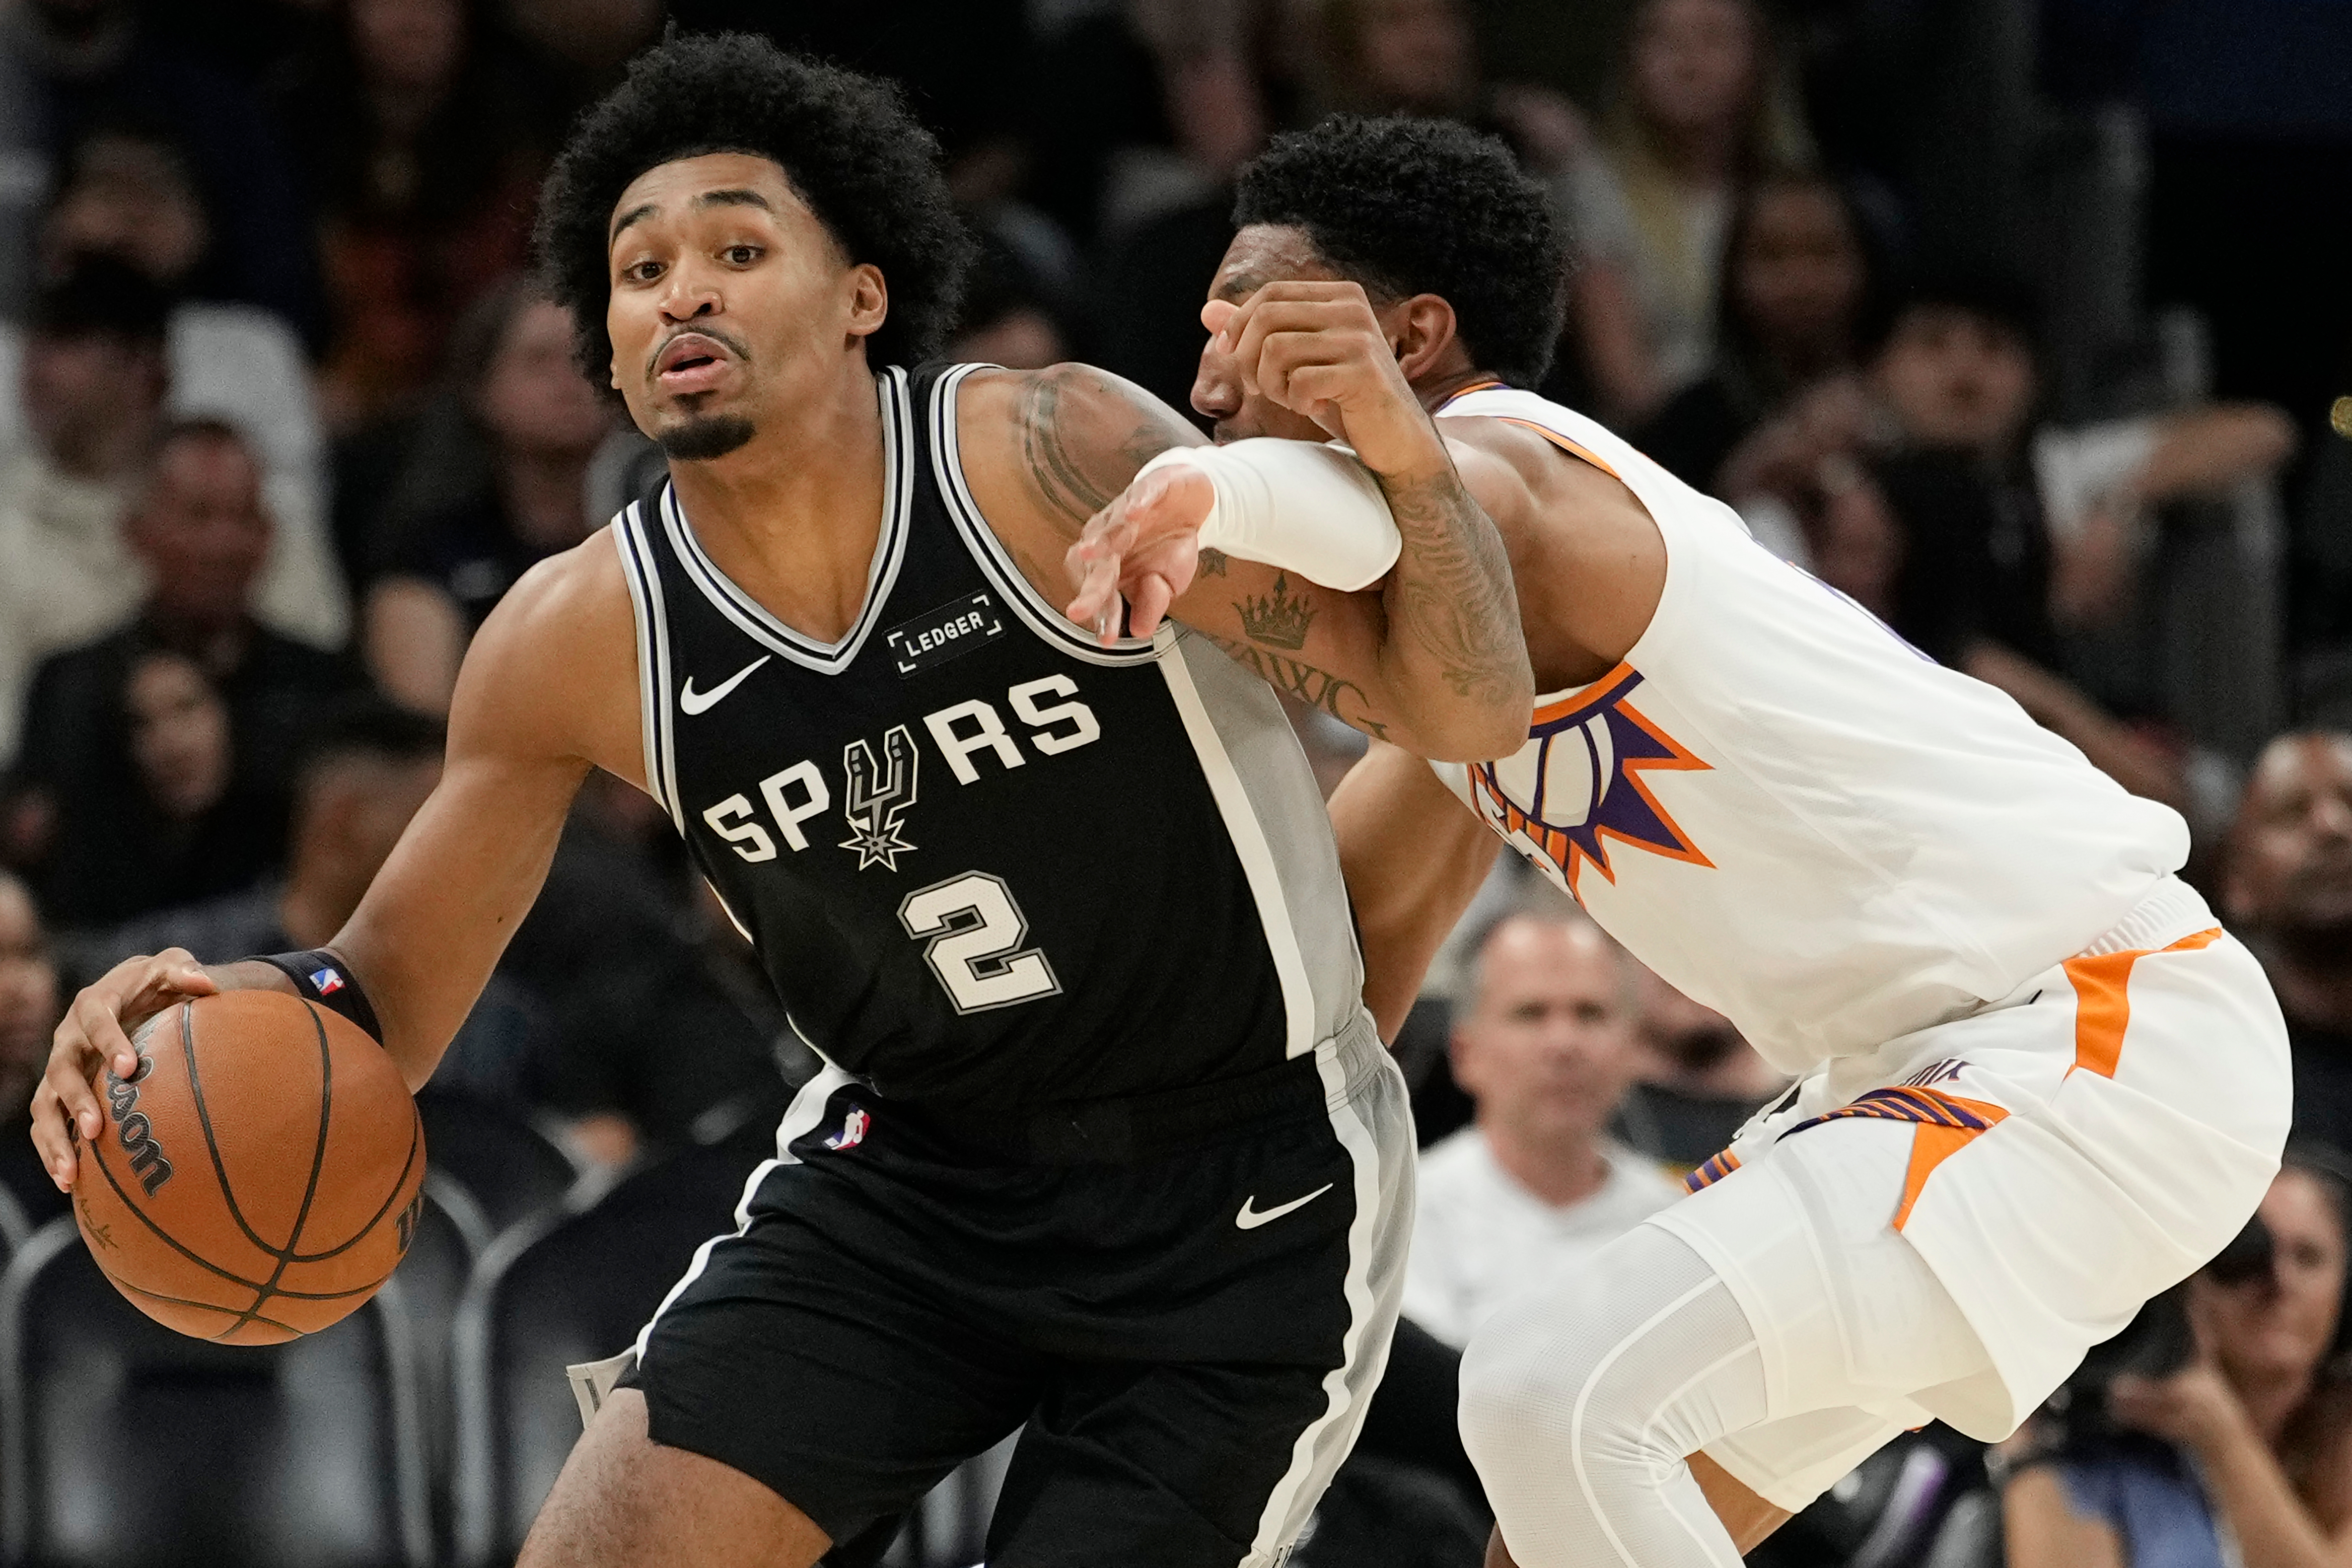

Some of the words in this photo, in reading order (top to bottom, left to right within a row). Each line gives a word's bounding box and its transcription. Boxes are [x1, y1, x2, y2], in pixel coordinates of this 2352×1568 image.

[905, 611, 984, 657] LEDGER
[702, 674, 1101, 872] SPURS
[896, 870, 1063, 1016] 2
[106, 1011, 174, 1199] son
